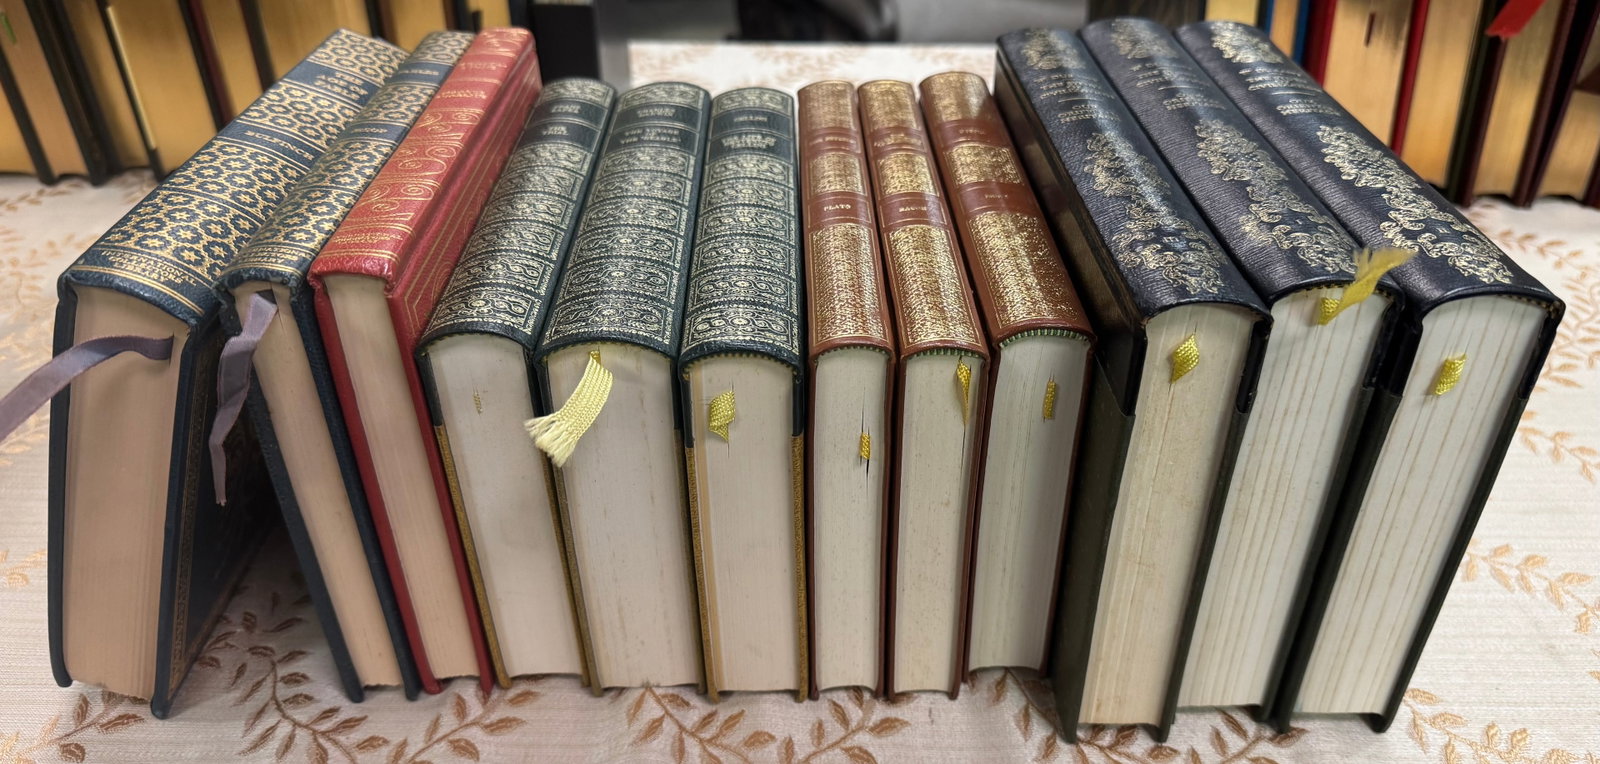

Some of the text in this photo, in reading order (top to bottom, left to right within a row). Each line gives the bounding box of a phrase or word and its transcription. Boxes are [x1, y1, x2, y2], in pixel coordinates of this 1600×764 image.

[244, 130, 315, 161] BULFINCH
[823, 203, 851, 212] PLATO
[101, 250, 197, 287] INTERNATIONAL
[108, 256, 184, 284] COLLECTORS
[113, 261, 169, 283] LIBRARY
